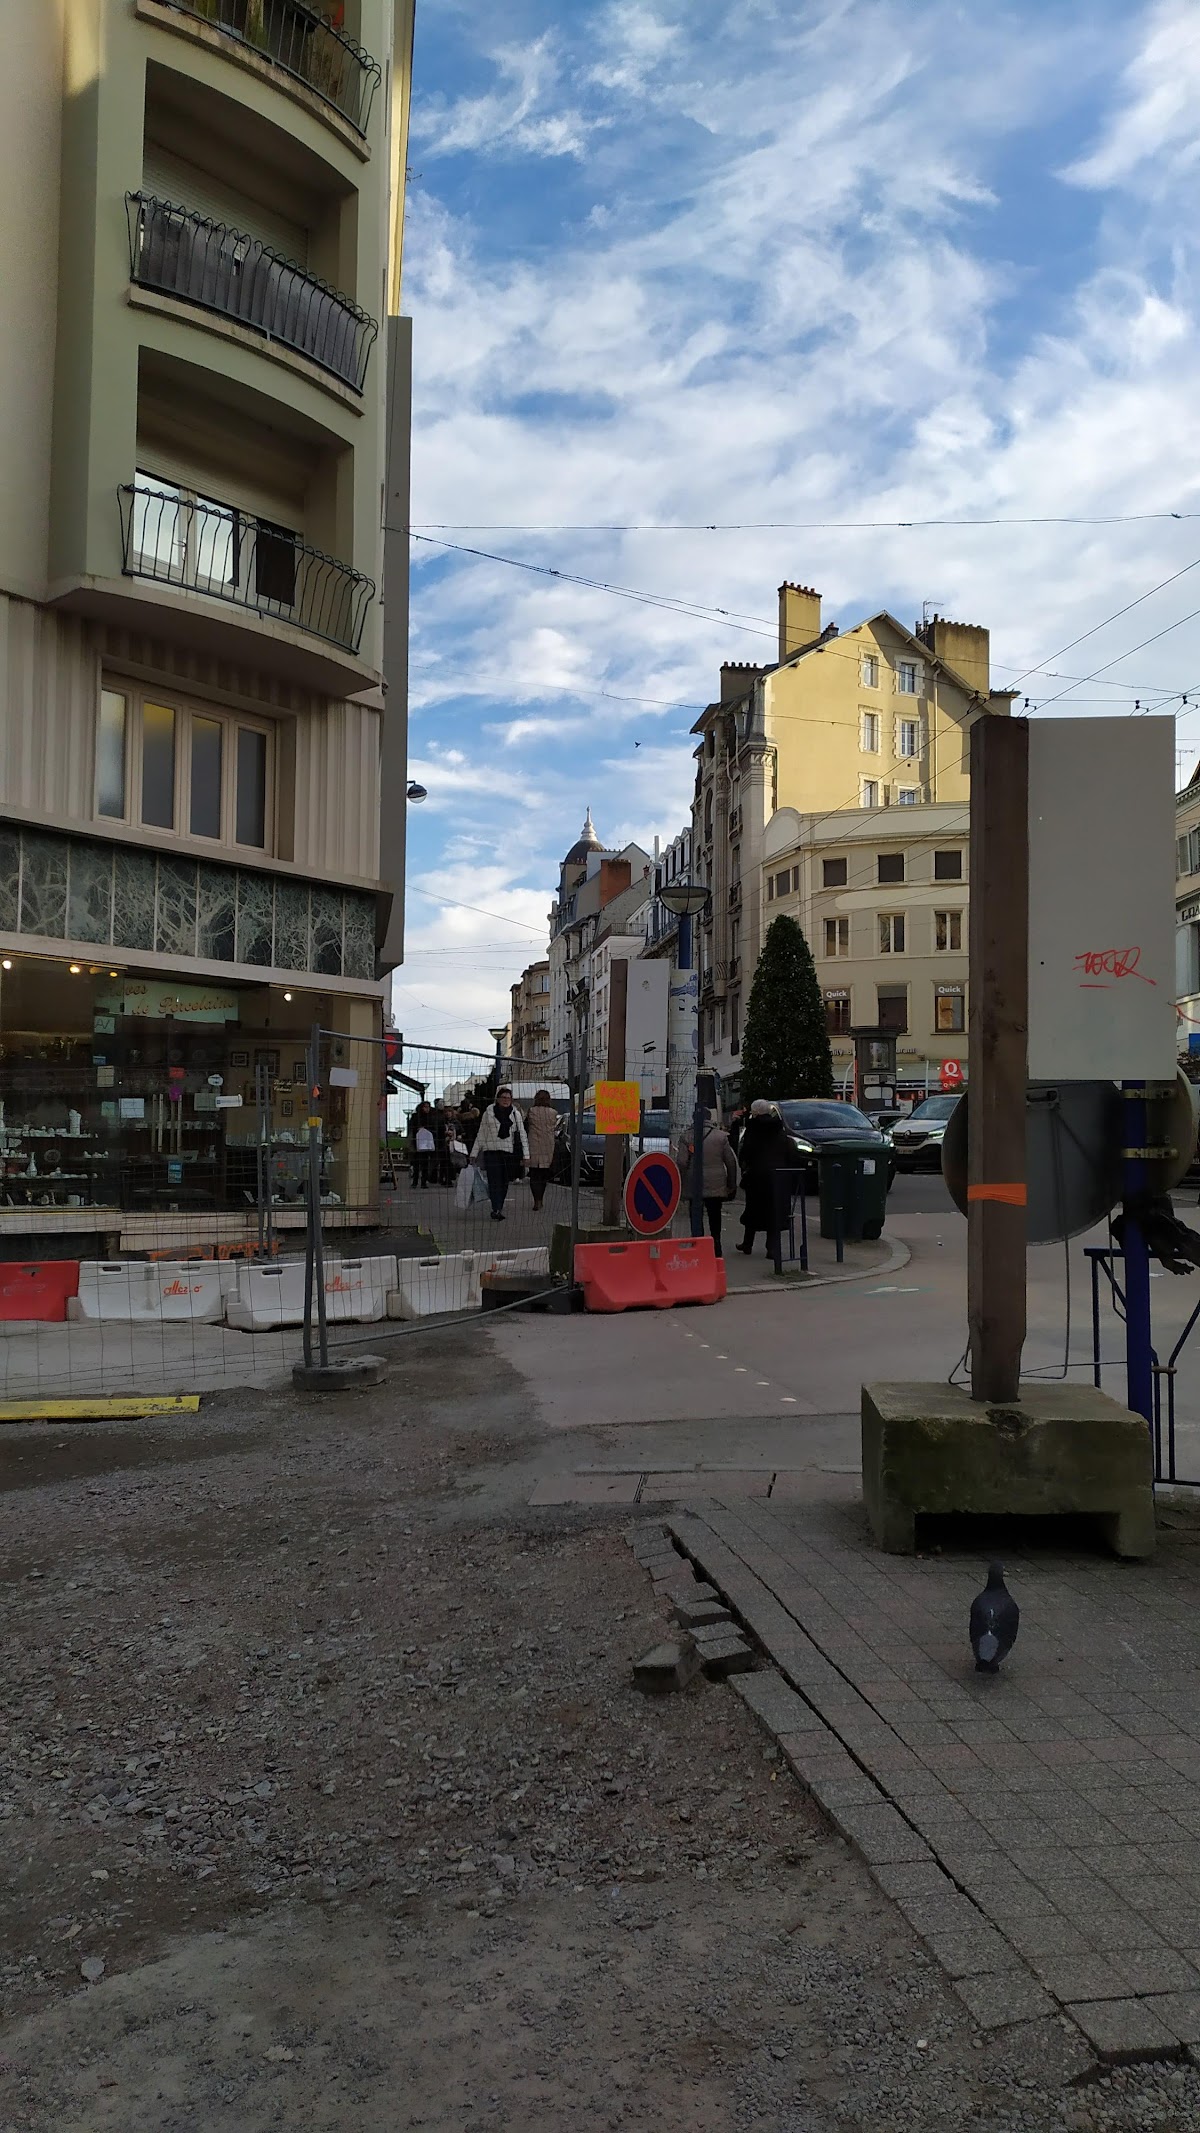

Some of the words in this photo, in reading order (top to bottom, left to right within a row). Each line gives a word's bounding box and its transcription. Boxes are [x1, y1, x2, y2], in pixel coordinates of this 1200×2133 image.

[826, 990, 847, 998] Quick
[938, 986, 961, 994] Quick
[944, 1061, 959, 1078] Q
